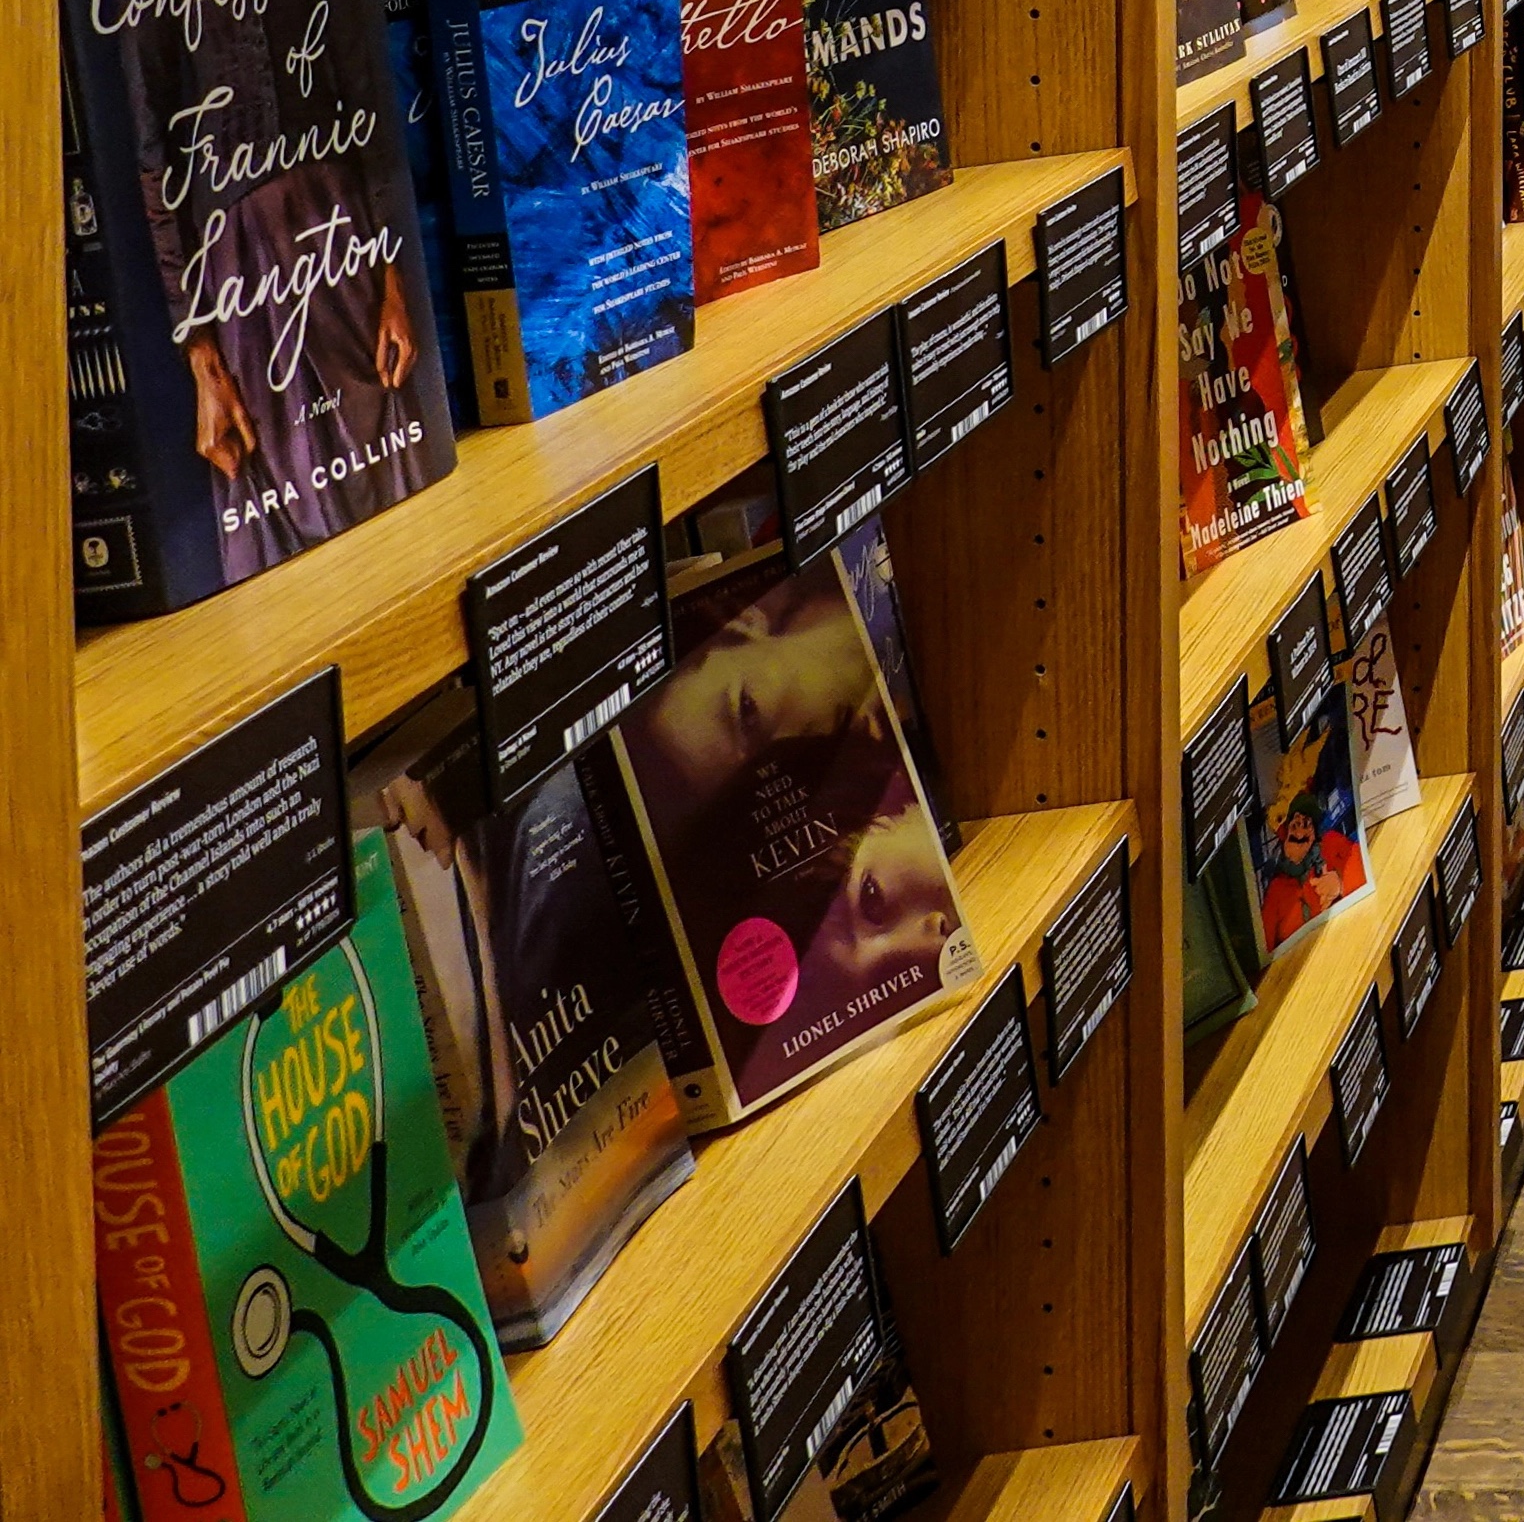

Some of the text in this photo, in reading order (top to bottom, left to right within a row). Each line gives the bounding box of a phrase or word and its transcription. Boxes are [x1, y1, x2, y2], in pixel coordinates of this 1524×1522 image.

[285, 0, 329, 98] of
[514, 6, 632, 108] Julius
[1193, 17, 1241, 49] SULLIVAN
[162, 83, 377, 211] Frannie
[444, 20, 491, 199] JULIUS CAESAR
[570, 74, 686, 163] Caesar
[812, 117, 941, 180] DEBORAH SHAPIRO
[172, 204, 403, 393] Langton
[1204, 249, 1244, 282] Not
[1180, 303, 1254, 363] Say We
[294, 389, 342, 426] A Novel
[1198, 366, 1251, 411] Have
[222, 421, 424, 532] SARA COLLINS
[1191, 411, 1278, 474] Nothing
[1190, 478, 1305, 550] Madeleine Thien
[751, 786, 810, 822] TO TALK
[755, 774, 793, 804] NEED
[763, 806, 809, 839] ABOUT
[750, 812, 841, 879] KEVIN
[283, 973, 321, 1032] THE
[508, 981, 596, 1088] Anita
[782, 1010, 845, 1061] LIONEL
[845, 964, 925, 1020] SHRIVER
[256, 994, 365, 1148] HOUSE
[515, 1034, 625, 1166] Shreve
[276, 1092, 372, 1203] OF GOD
[358, 1327, 459, 1464] SAMUEL
[387, 1369, 472, 1494] SHEM
